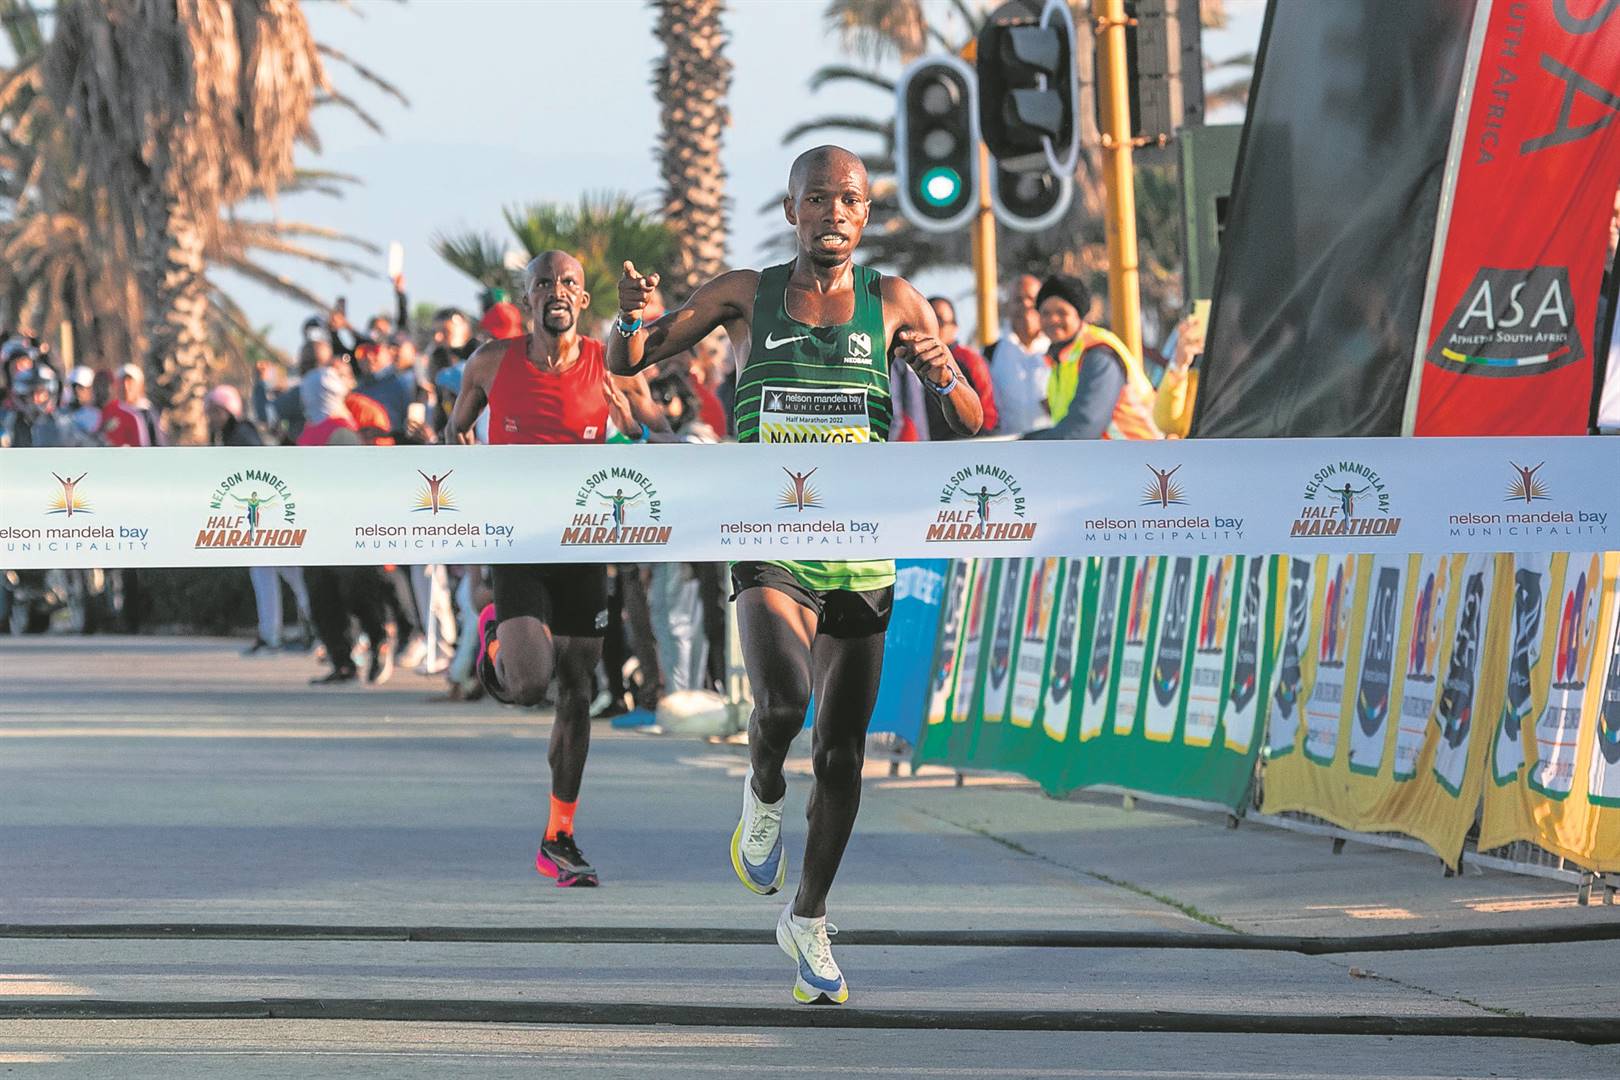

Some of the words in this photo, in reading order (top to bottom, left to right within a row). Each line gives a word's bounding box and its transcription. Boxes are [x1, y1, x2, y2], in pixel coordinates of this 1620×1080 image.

[1476, 64, 1519, 166] AFRICA
[1458, 279, 1568, 330] ASA
[1497, 331, 1533, 343] SOUTH
[785, 393, 812, 403] nelson
[814, 394, 848, 403] mandela
[849, 394, 862, 404] bay
[784, 403, 862, 411] MUNICIPALITY
[575, 469, 608, 507] NELSON
[611, 466, 657, 498] MANDELA
[649, 499, 661, 522] BAY
[940, 467, 973, 504] NELSON
[975, 464, 1021, 496] MANDELA
[1013, 496, 1026, 519] BAY
[1304, 464, 1336, 500] NELSON
[1339, 461, 1385, 493] MANDELA
[1377, 493, 1389, 514] BAY
[210, 473, 244, 509] NELSON
[246, 469, 292, 501] MANDELA
[284, 502, 296, 524] BAY
[572, 513, 611, 526] HALF
[937, 510, 975, 523] HALF
[1301, 506, 1339, 519] HALF
[1449, 512, 1500, 525] nelson
[1506, 511, 1574, 524] mandela
[1578, 511, 1608, 526] bay
[206, 516, 246, 529] HALF
[355, 523, 407, 536] nelson
[412, 523, 480, 536] mandela
[485, 522, 514, 538] bay
[720, 521, 772, 534] nelson
[777, 520, 845, 533] mandela
[850, 520, 879, 536] bay
[1085, 517, 1137, 530] nelson
[1142, 517, 1209, 529] mandela
[1215, 516, 1244, 531] bay
[1291, 518, 1402, 536] MARATHON
[0, 526, 41, 539] elson
[46, 526, 115, 539] mandela
[119, 525, 149, 541] bay
[194, 529, 307, 547] MARATHON
[561, 526, 673, 544] MARATHON
[926, 523, 1037, 540] MARATHON
[1085, 531, 1244, 541] MUNICIPALITY
[1449, 526, 1608, 536] MUNICIPALITY
[7, 542, 150, 552] UNICIPALITY
[355, 539, 515, 549] MUNICIPALITY
[721, 536, 880, 545] MUNICIPALITY
